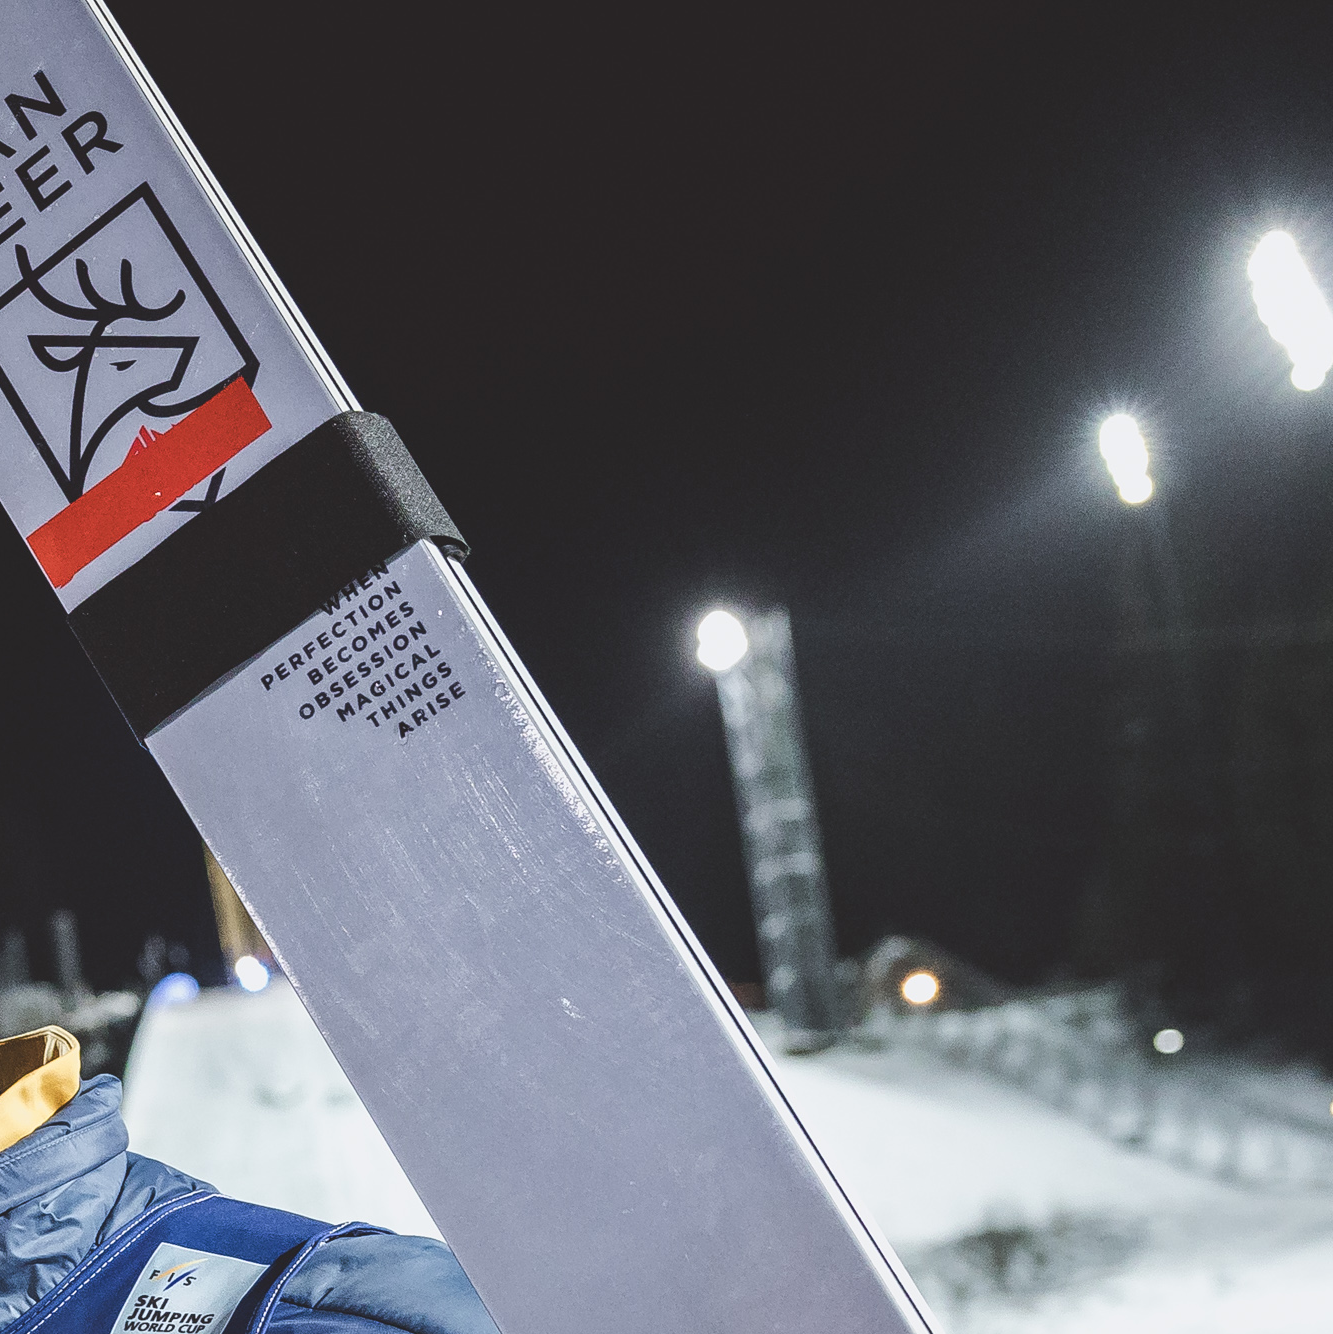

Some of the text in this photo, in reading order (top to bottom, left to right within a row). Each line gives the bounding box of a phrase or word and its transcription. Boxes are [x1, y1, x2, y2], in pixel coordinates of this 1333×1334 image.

[260, 580, 402, 691] PERFECTION
[306, 601, 414, 686] BECOMES
[298, 620, 427, 720] OBSESSION
[336, 644, 441, 722] MAGICAL
[366, 661, 452, 728] THINGS
[398, 681, 466, 739] ARISE
[123, 1321, 205, 1334] WORLD CUP
[127, 1308, 214, 1325] JUMPING
[134, 1294, 169, 1310] SKI
